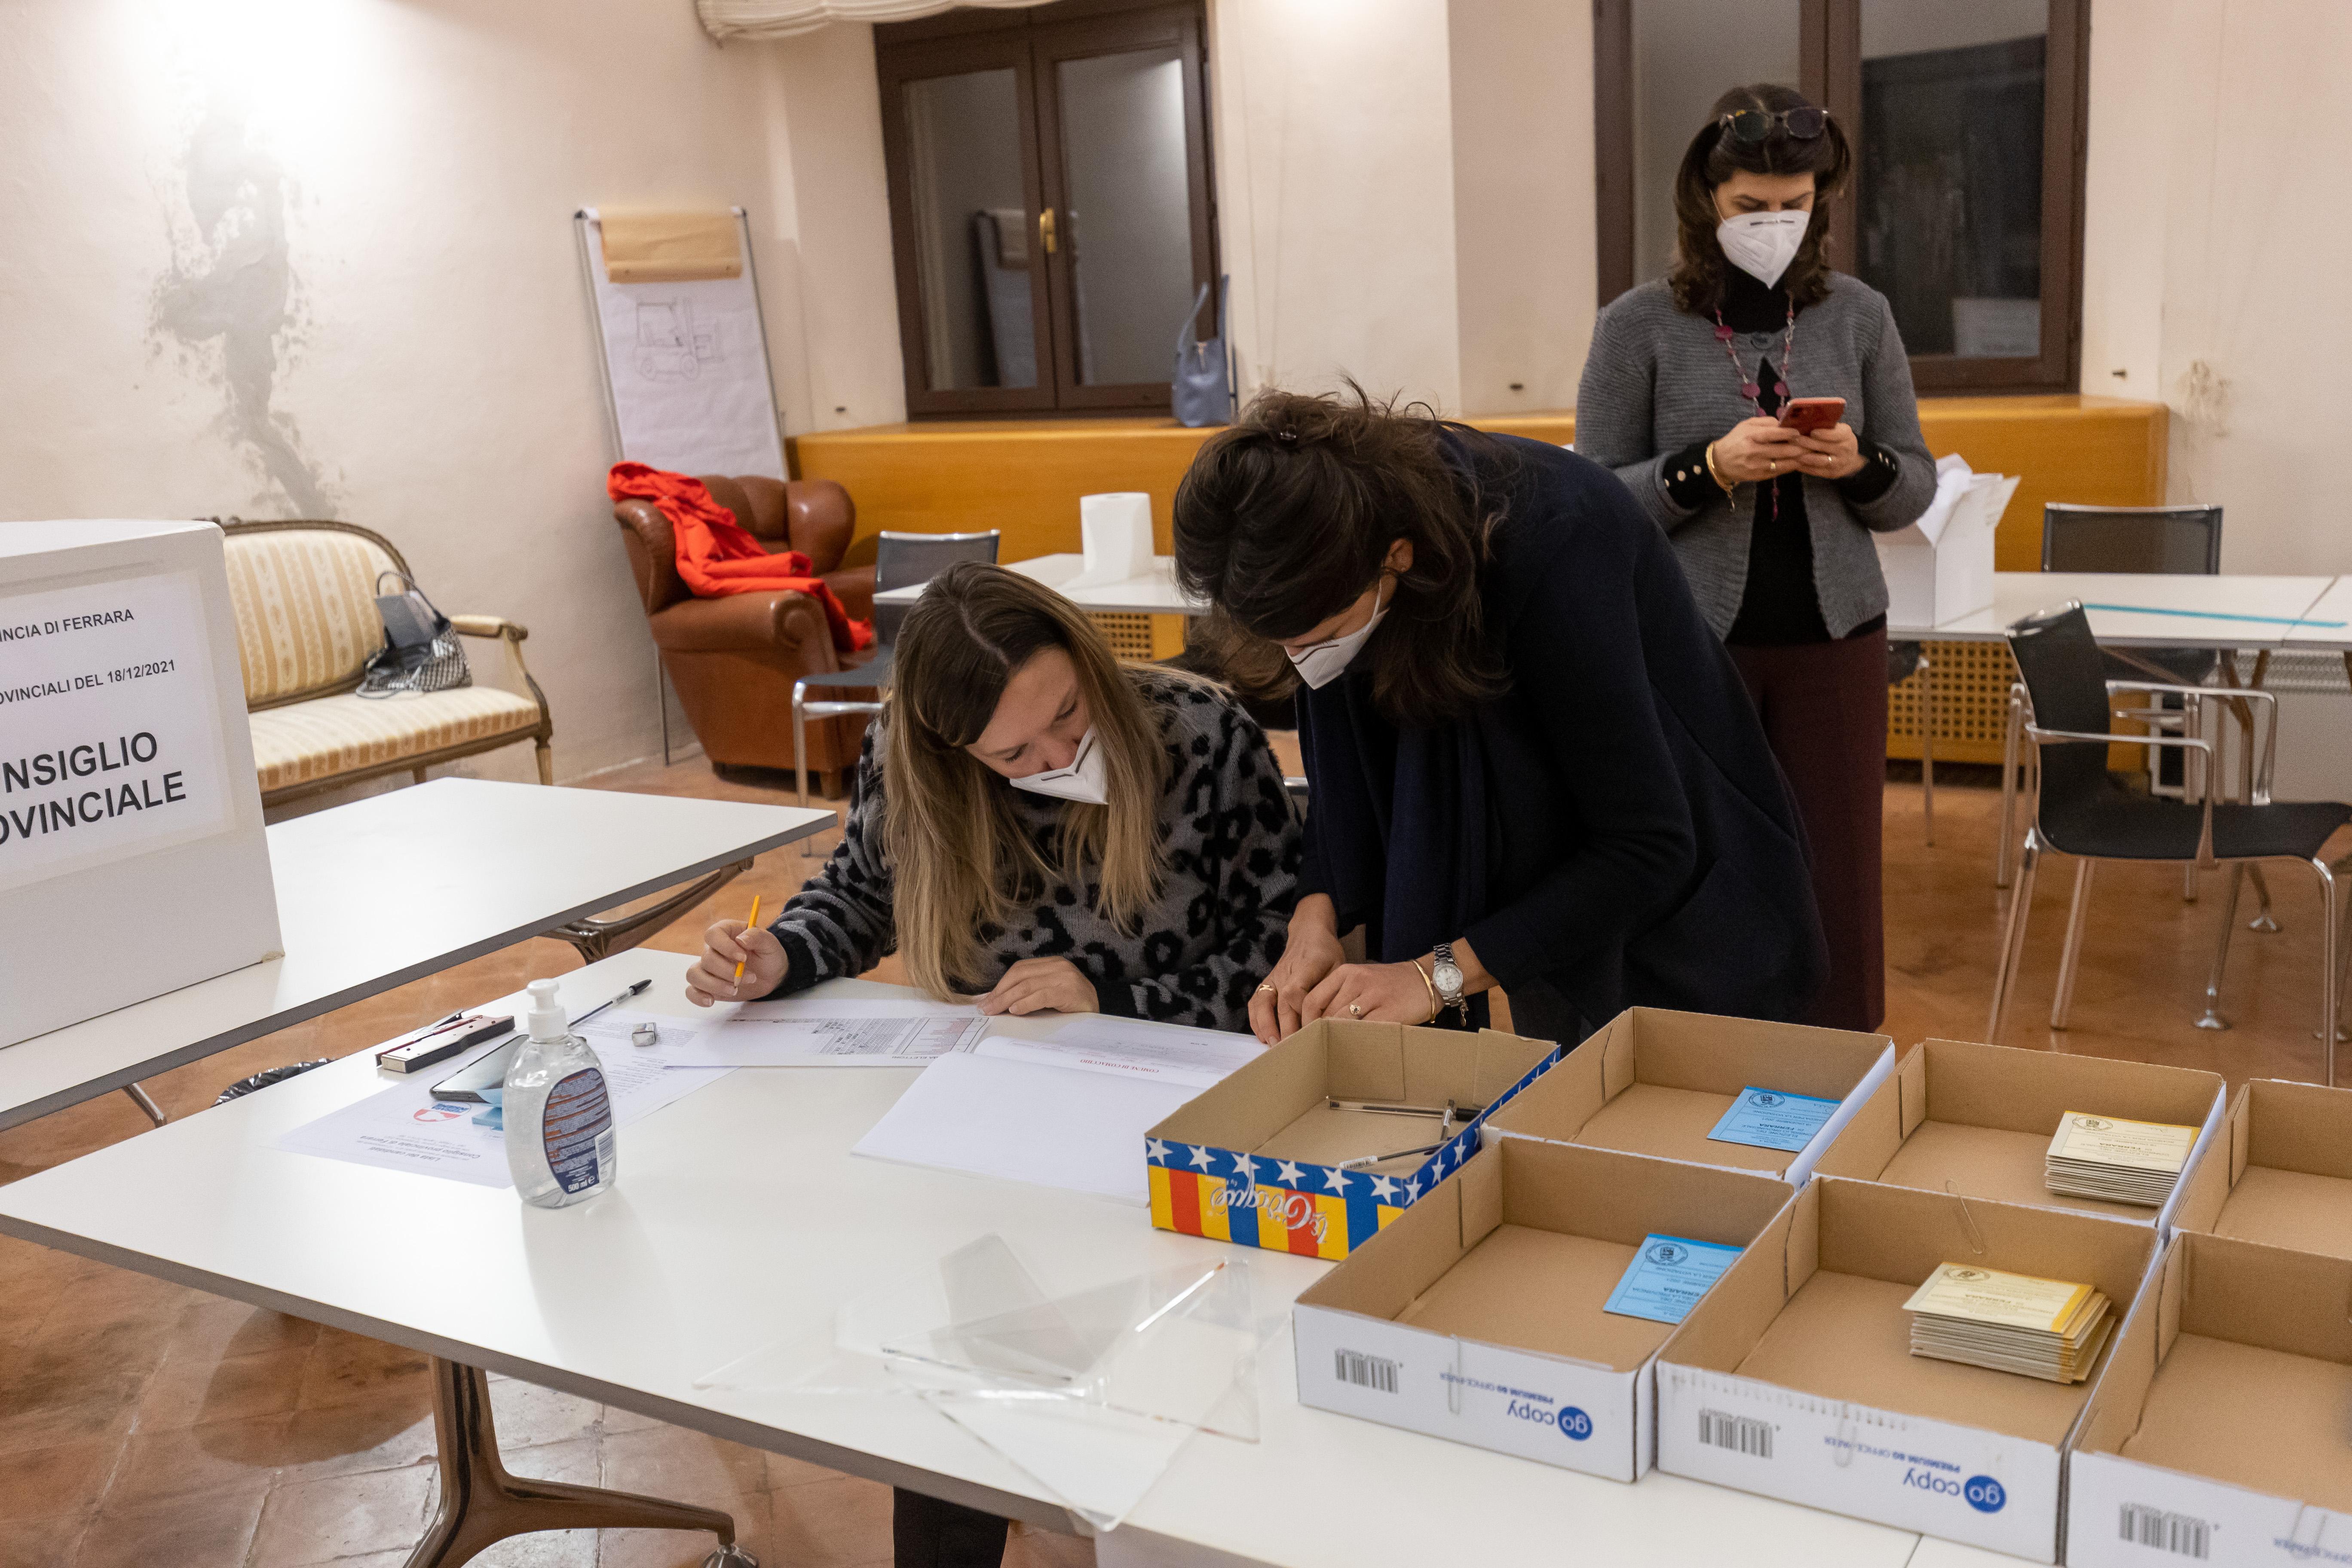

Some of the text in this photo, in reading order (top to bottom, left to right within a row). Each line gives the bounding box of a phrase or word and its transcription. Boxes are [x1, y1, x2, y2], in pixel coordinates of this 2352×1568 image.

[44, 621, 59, 634] DI
[63, 609, 134, 631] FERRARA
[75, 674, 103, 689] DEL
[107, 659, 175, 683] 18/12/2021
[2, 732, 158, 793] NSIGLIO
[1507, 1400, 1588, 1434] go copy
[1903, 1468, 2000, 1505] go copy
